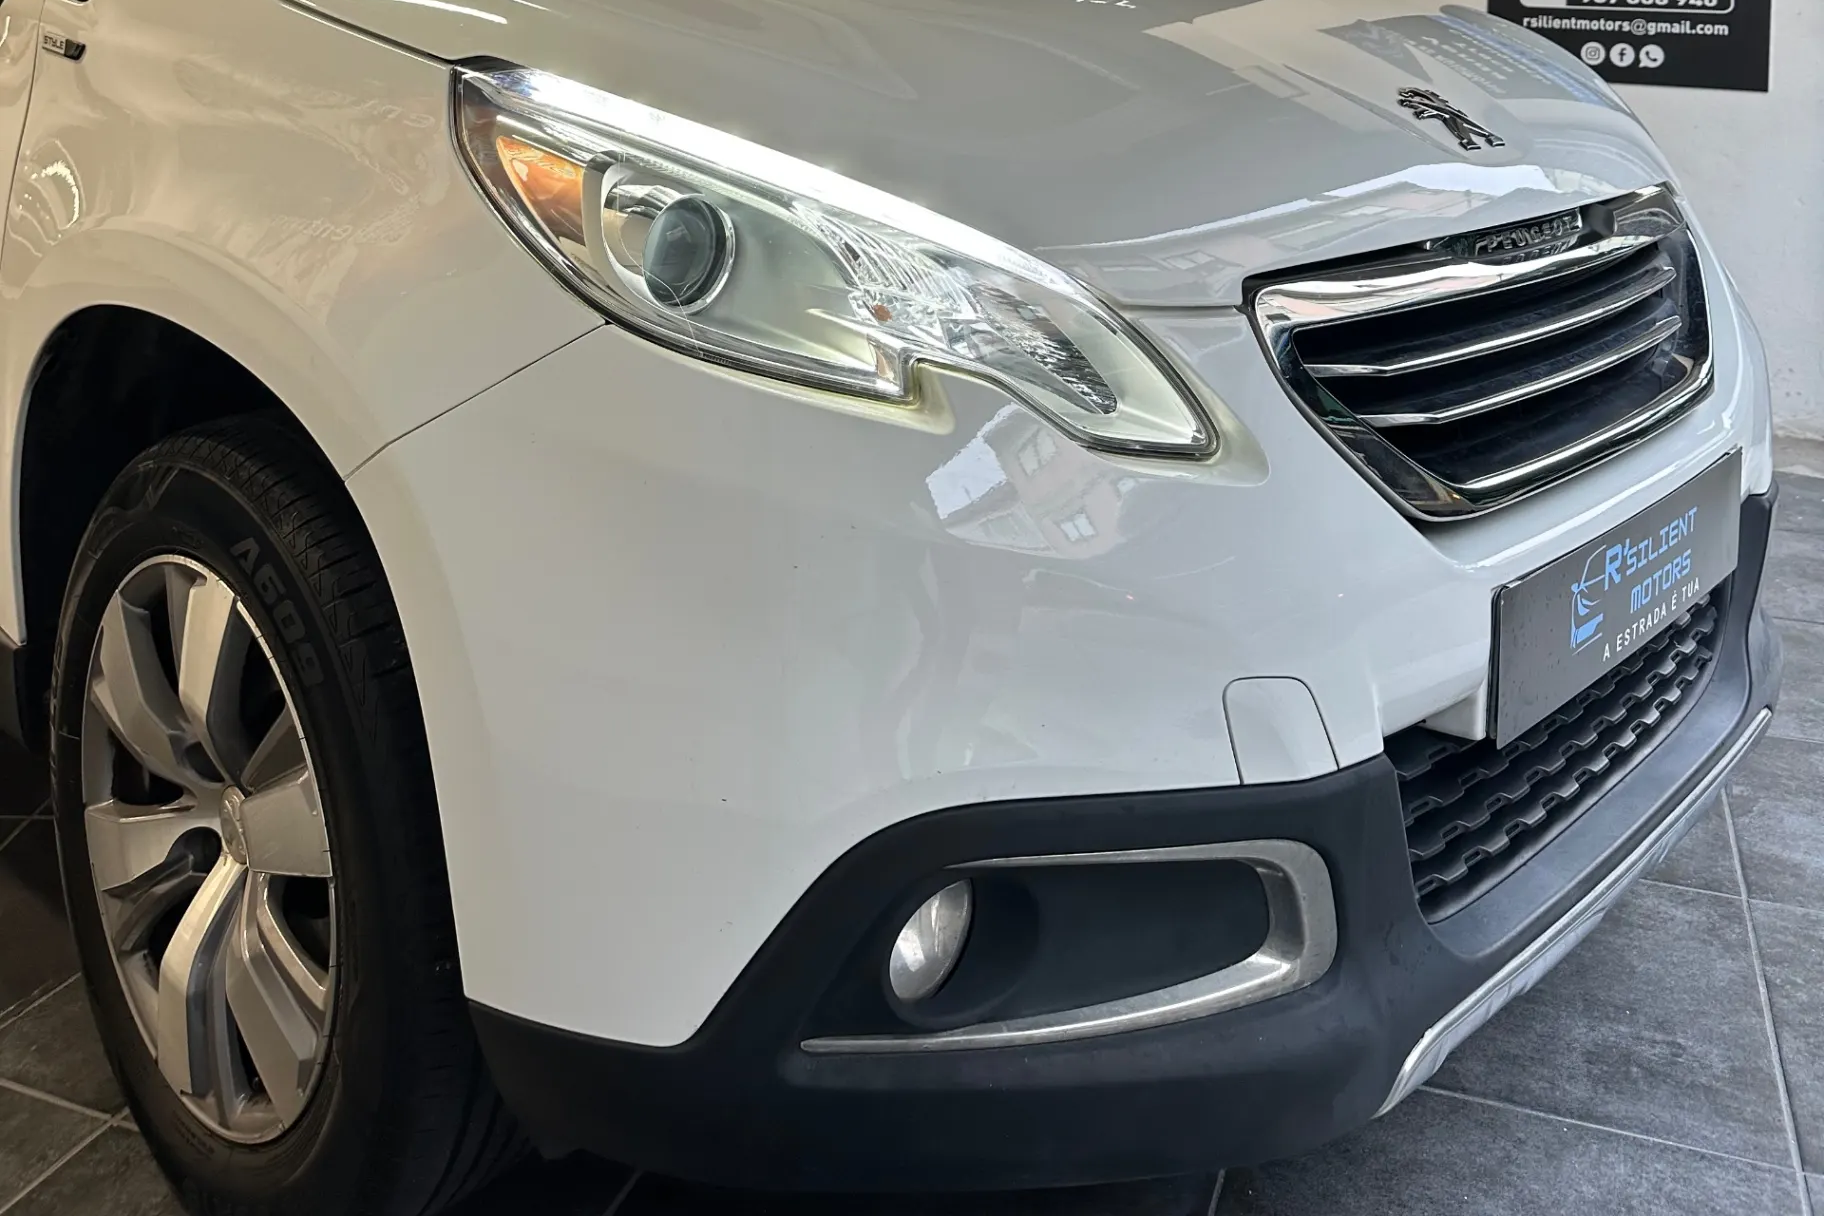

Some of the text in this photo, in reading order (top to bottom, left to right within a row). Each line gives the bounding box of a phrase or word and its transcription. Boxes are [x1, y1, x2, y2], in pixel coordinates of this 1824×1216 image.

[1522, 15, 1729, 36] rsilientmotors@gmail.com
[1630, 549, 1692, 614] MOTORS
[1602, 643, 1611, 662] A
[1616, 602, 1667, 652] ESTRADA
[1681, 577, 1700, 602] TUA
